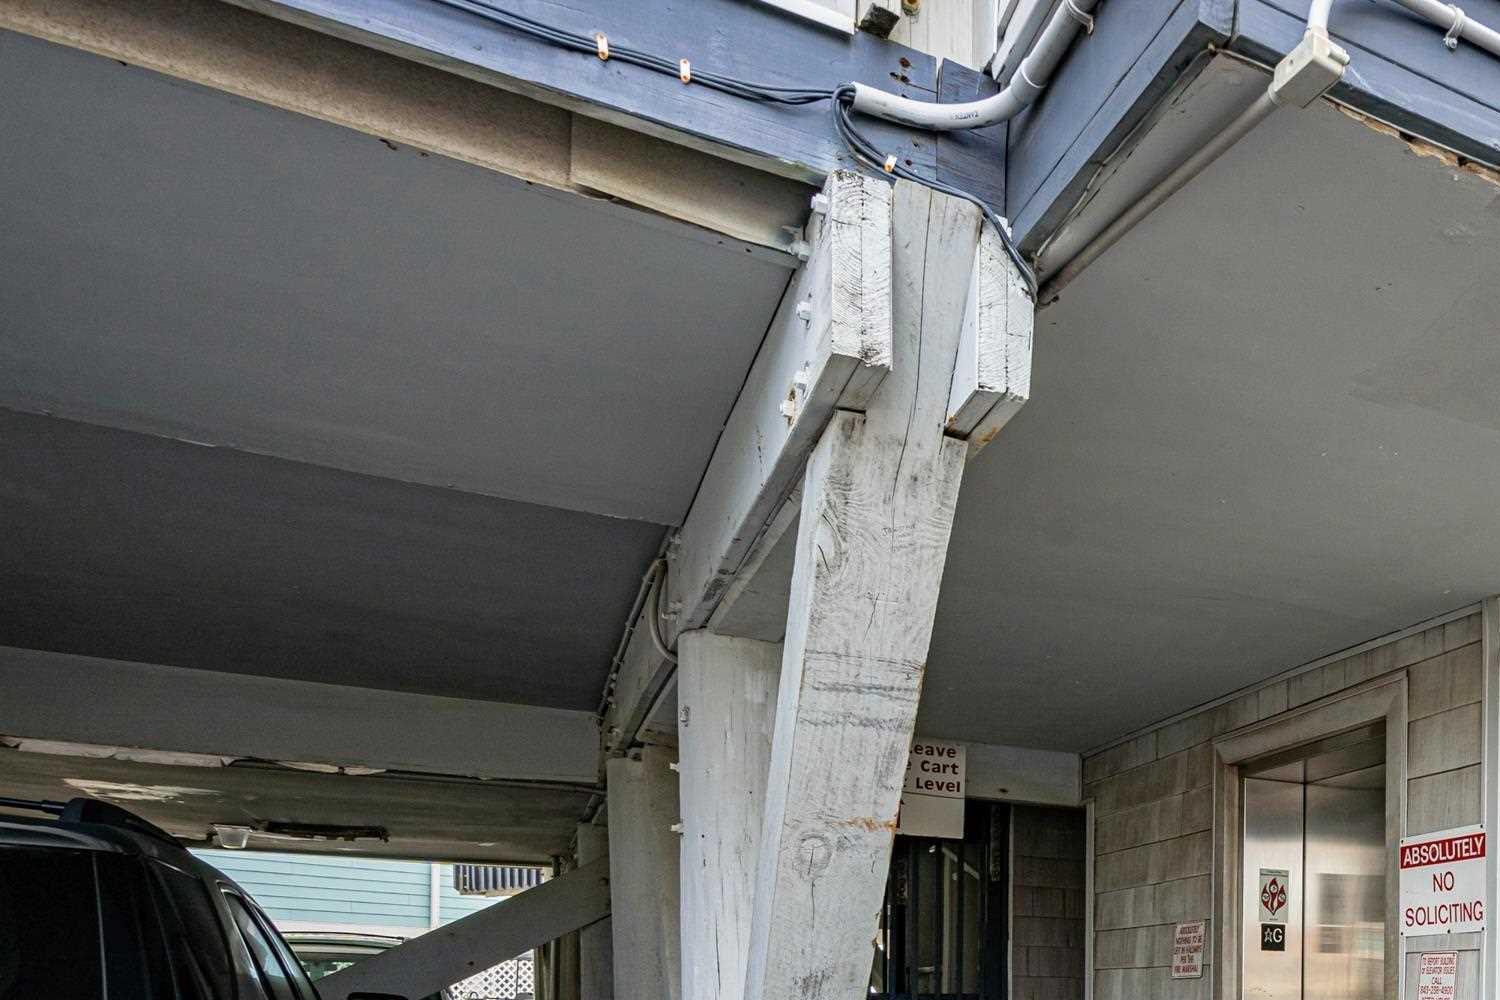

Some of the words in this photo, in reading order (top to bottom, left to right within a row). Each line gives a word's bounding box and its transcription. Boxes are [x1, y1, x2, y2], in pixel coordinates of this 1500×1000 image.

[910, 743, 957, 759] eave
[920, 760, 960, 775] Cart
[915, 777, 961, 793] Level
[1402, 834, 1485, 866] ABSOLUTELY
[1432, 871, 1455, 892] NO
[1404, 900, 1484, 928] SOLICITING
[1273, 928, 1283, 943] G
